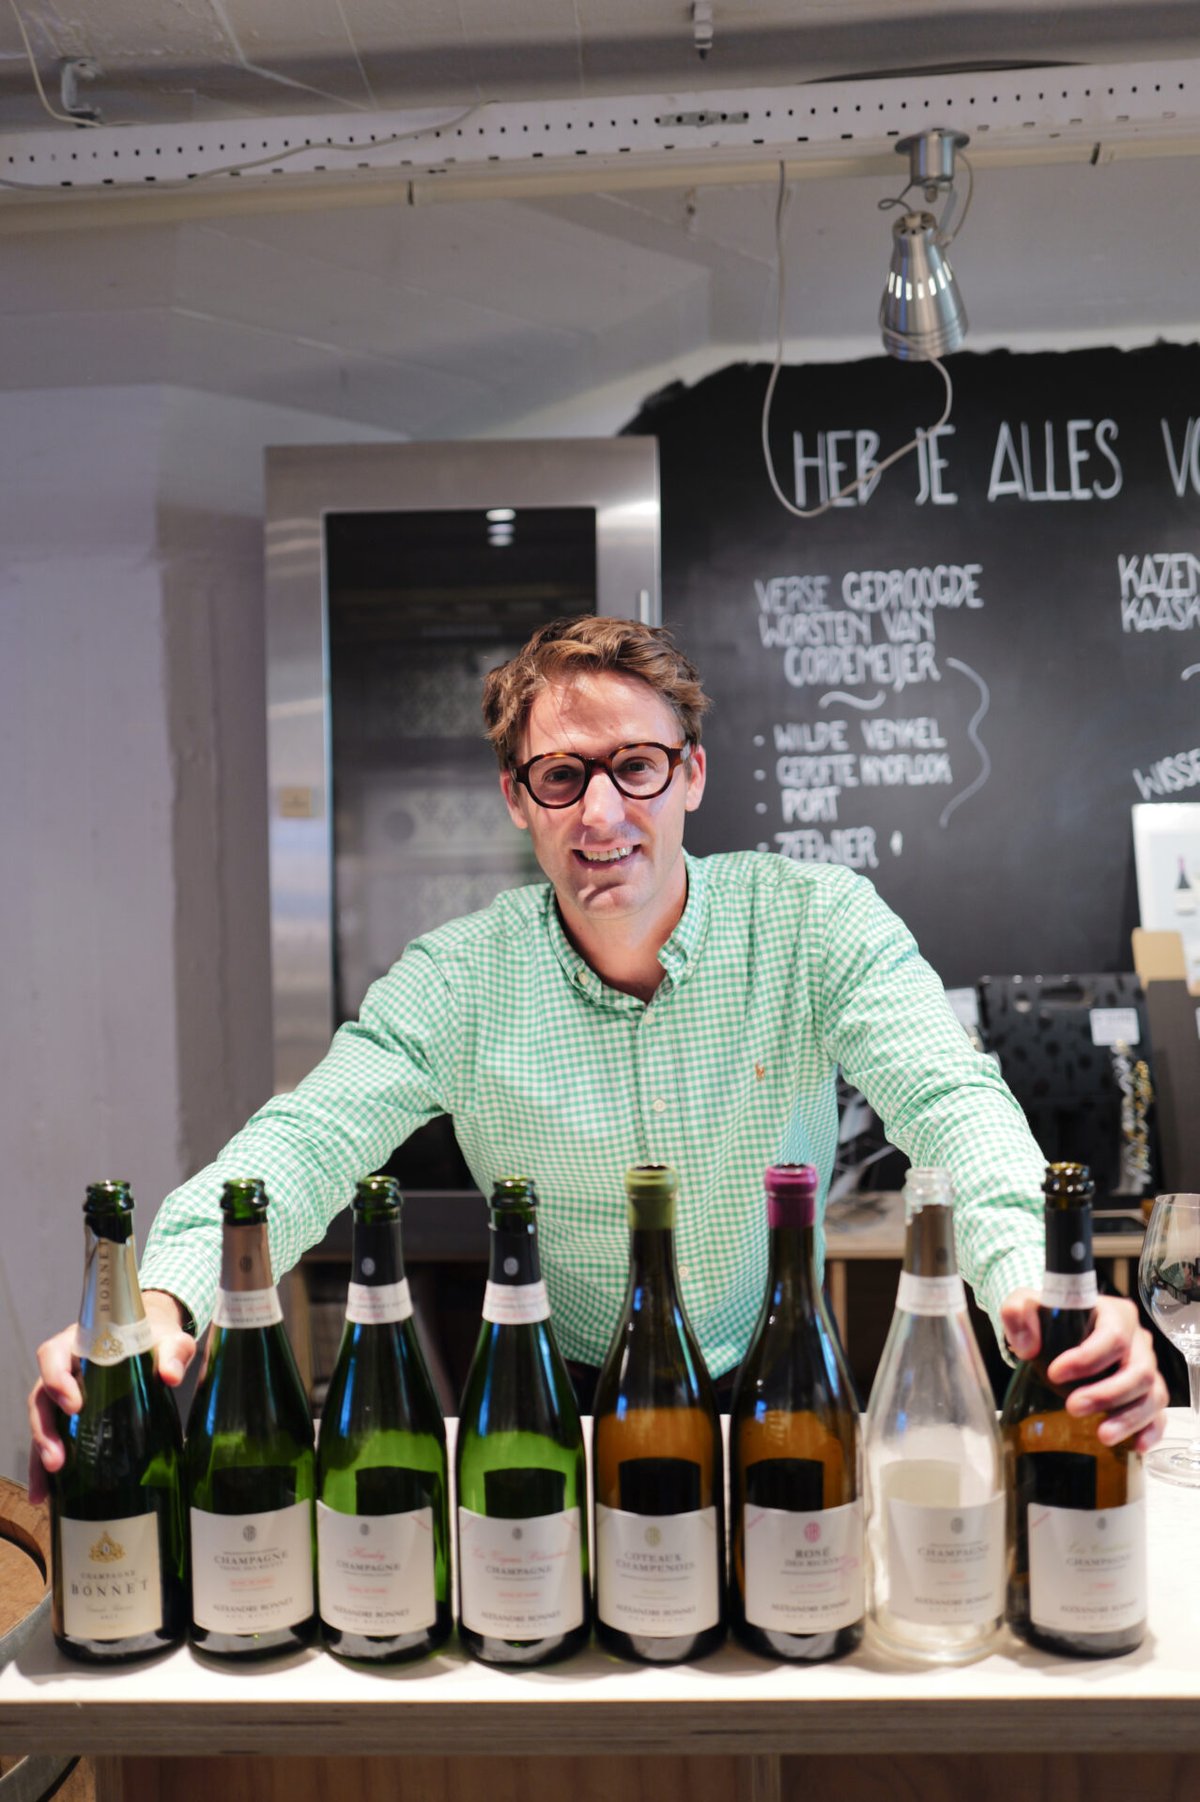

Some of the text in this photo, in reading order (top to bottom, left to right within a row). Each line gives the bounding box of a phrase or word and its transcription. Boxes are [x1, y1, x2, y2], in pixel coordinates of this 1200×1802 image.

[793, 430, 882, 507] HEB
[915, 424, 958, 506] JE
[987, 418, 1123, 501] ALLES
[754, 564, 984, 614] VERSE GEDROOGDE
[758, 608, 936, 648] WORSTEN VAN
[773, 720, 849, 751] WILDE
[781, 785, 841, 823] PORT
[213, 1550, 288, 1566] CHAMPAGNE
[624, 1551, 683, 1563] COTEAUX
[794, 1546, 831, 1558] ROSÉ
[336, 1559, 401, 1572] CHAMPAGNE
[485, 1564, 553, 1576] CHAMPAGNE
[615, 1558, 696, 1573] CHAMPENOIS
[80, 1569, 136, 1580] CHAMPAGNE
[71, 1578, 149, 1598] BONNET
